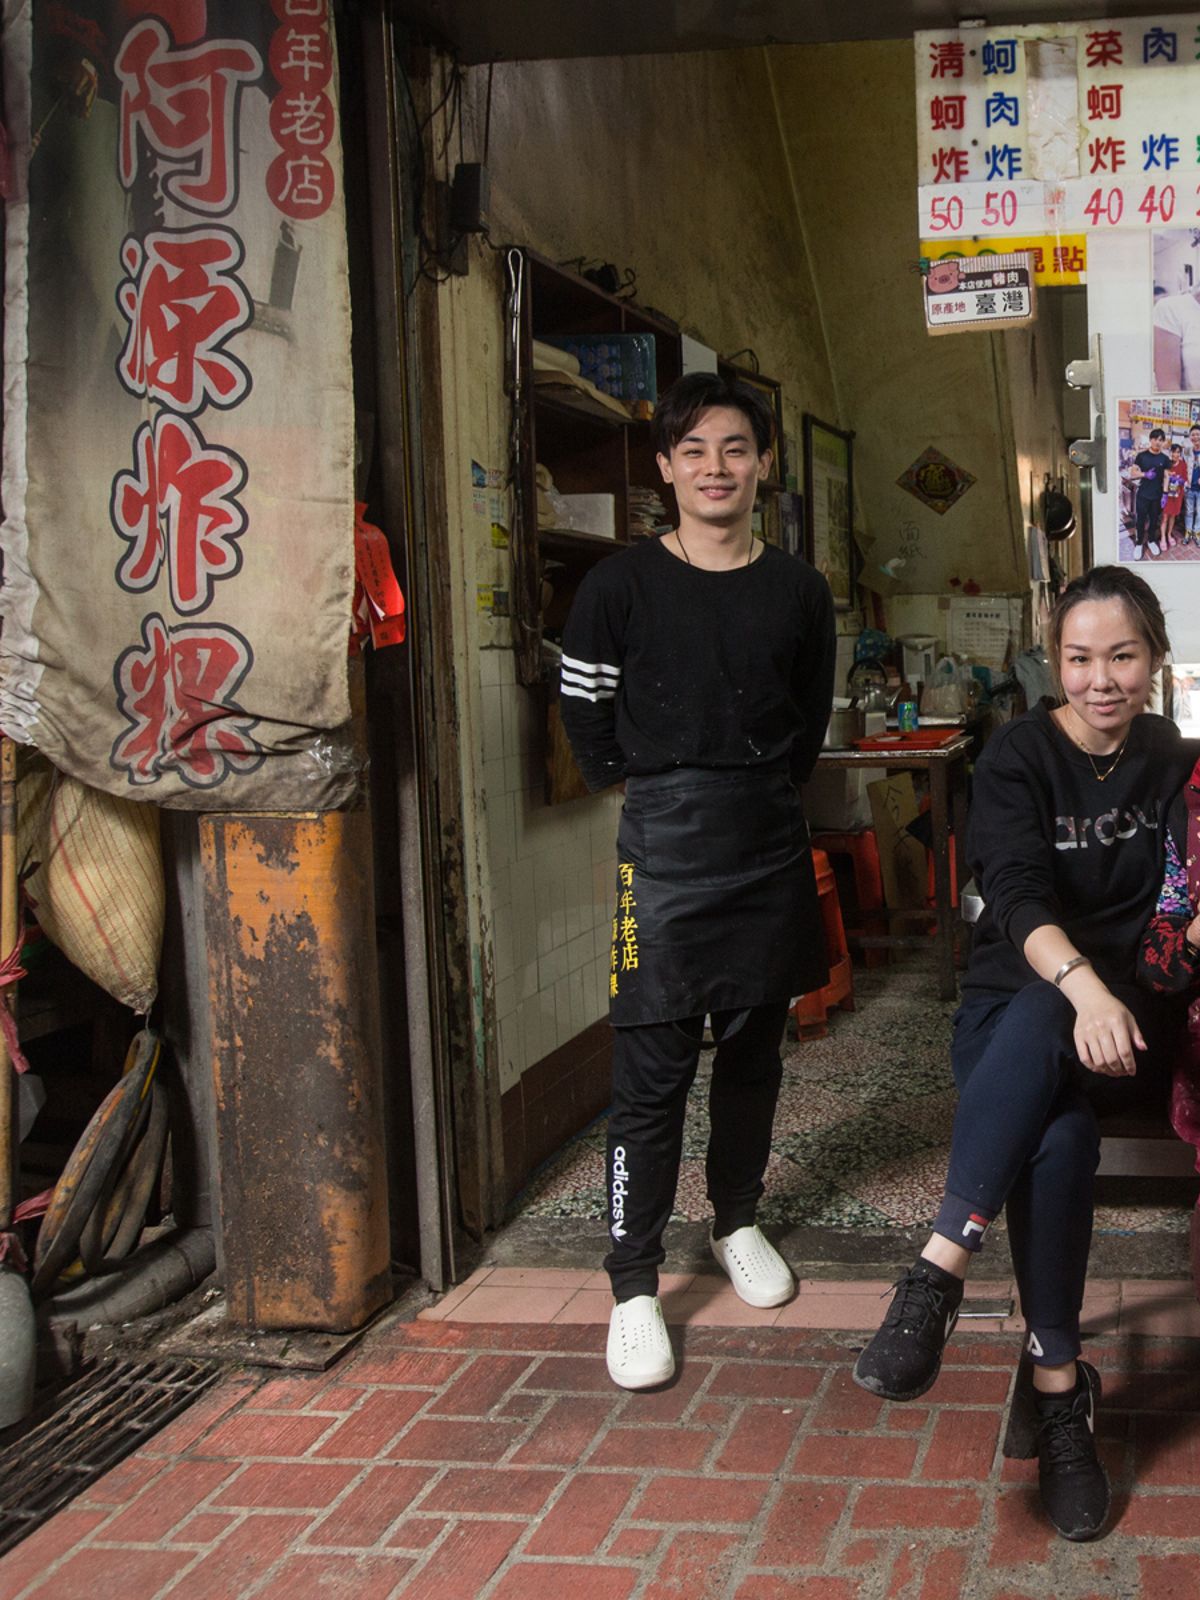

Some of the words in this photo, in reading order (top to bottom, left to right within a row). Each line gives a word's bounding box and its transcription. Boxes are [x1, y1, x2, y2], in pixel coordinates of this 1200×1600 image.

[929, 42, 969, 183] 清蚵炸
[982, 38, 1022, 182] 蚵肉炸
[1085, 30, 1126, 174] 菜蚵炸
[1142, 27, 1180, 171] 肉炸
[929, 196, 963, 231] 50
[981, 190, 1018, 226] 50
[1084, 187, 1124, 225] 40
[1138, 185, 1175, 223] 40
[931, 300, 967, 316] 原產地
[976, 290, 1024, 315] 臺灣
[618, 863, 639, 972] 百年老店
[612, 1146, 629, 1220] adidas
